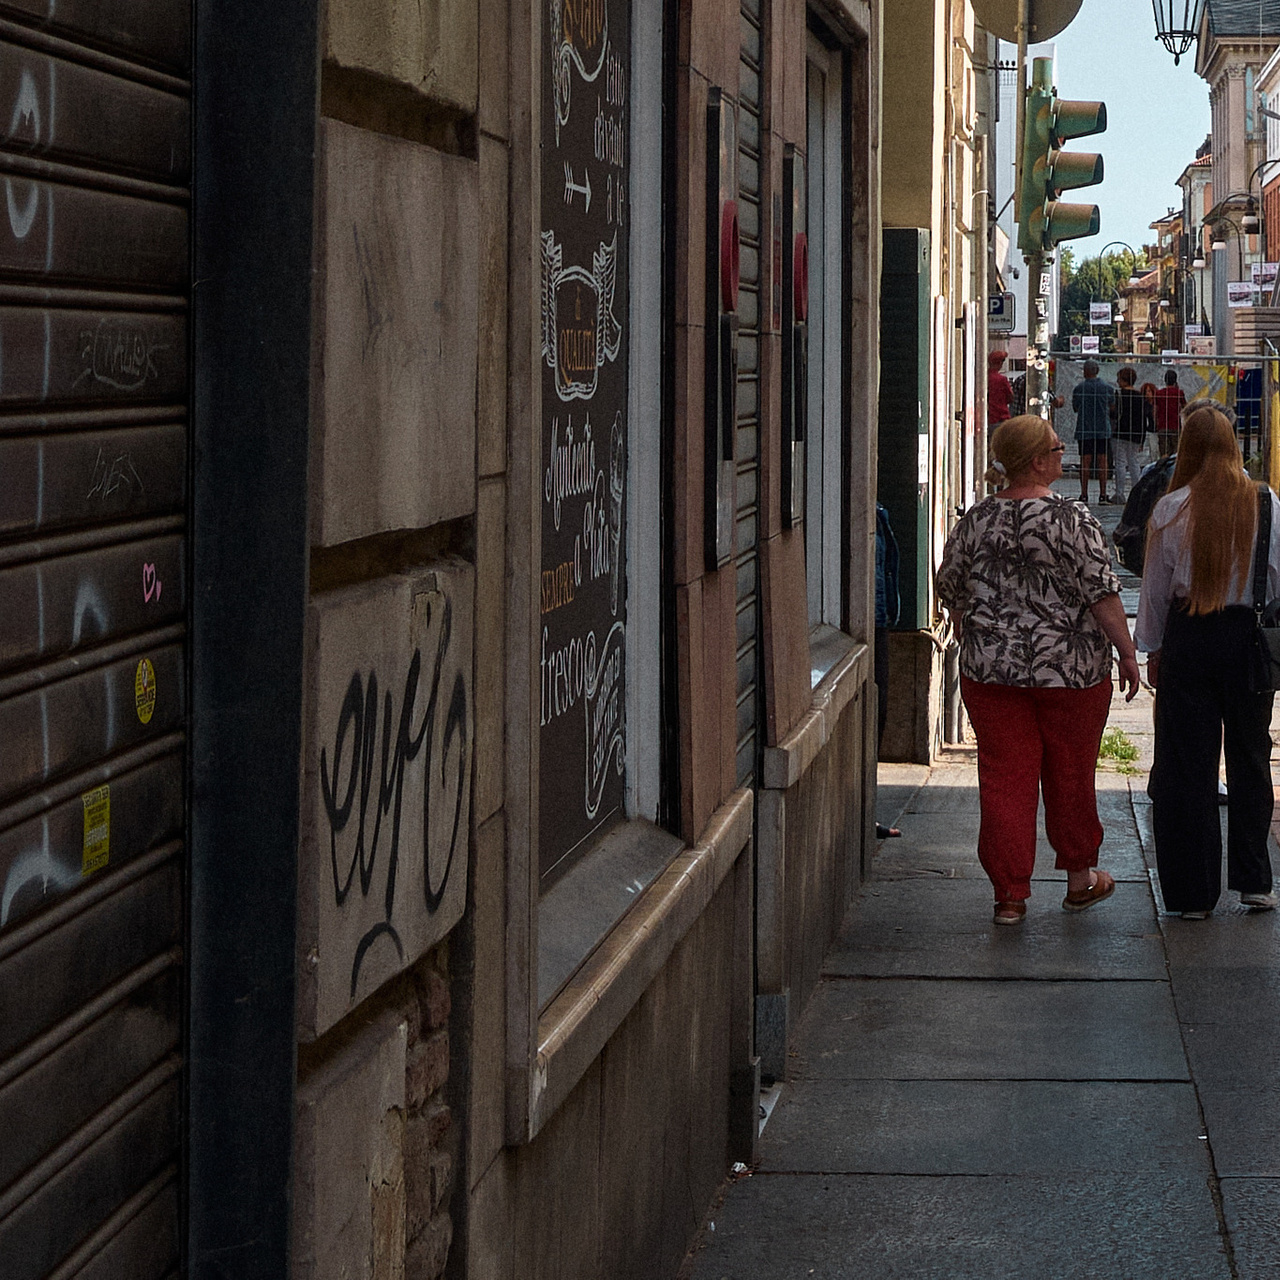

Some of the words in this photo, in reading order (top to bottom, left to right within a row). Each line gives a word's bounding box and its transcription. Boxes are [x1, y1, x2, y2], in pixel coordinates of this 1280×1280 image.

[606, 40, 625, 107] fatto
[594, 95, 625, 168] davanti
[990, 299, 1001, 313] P
[541, 560, 575, 615] SEMPRE
[540, 625, 583, 726] fresco
